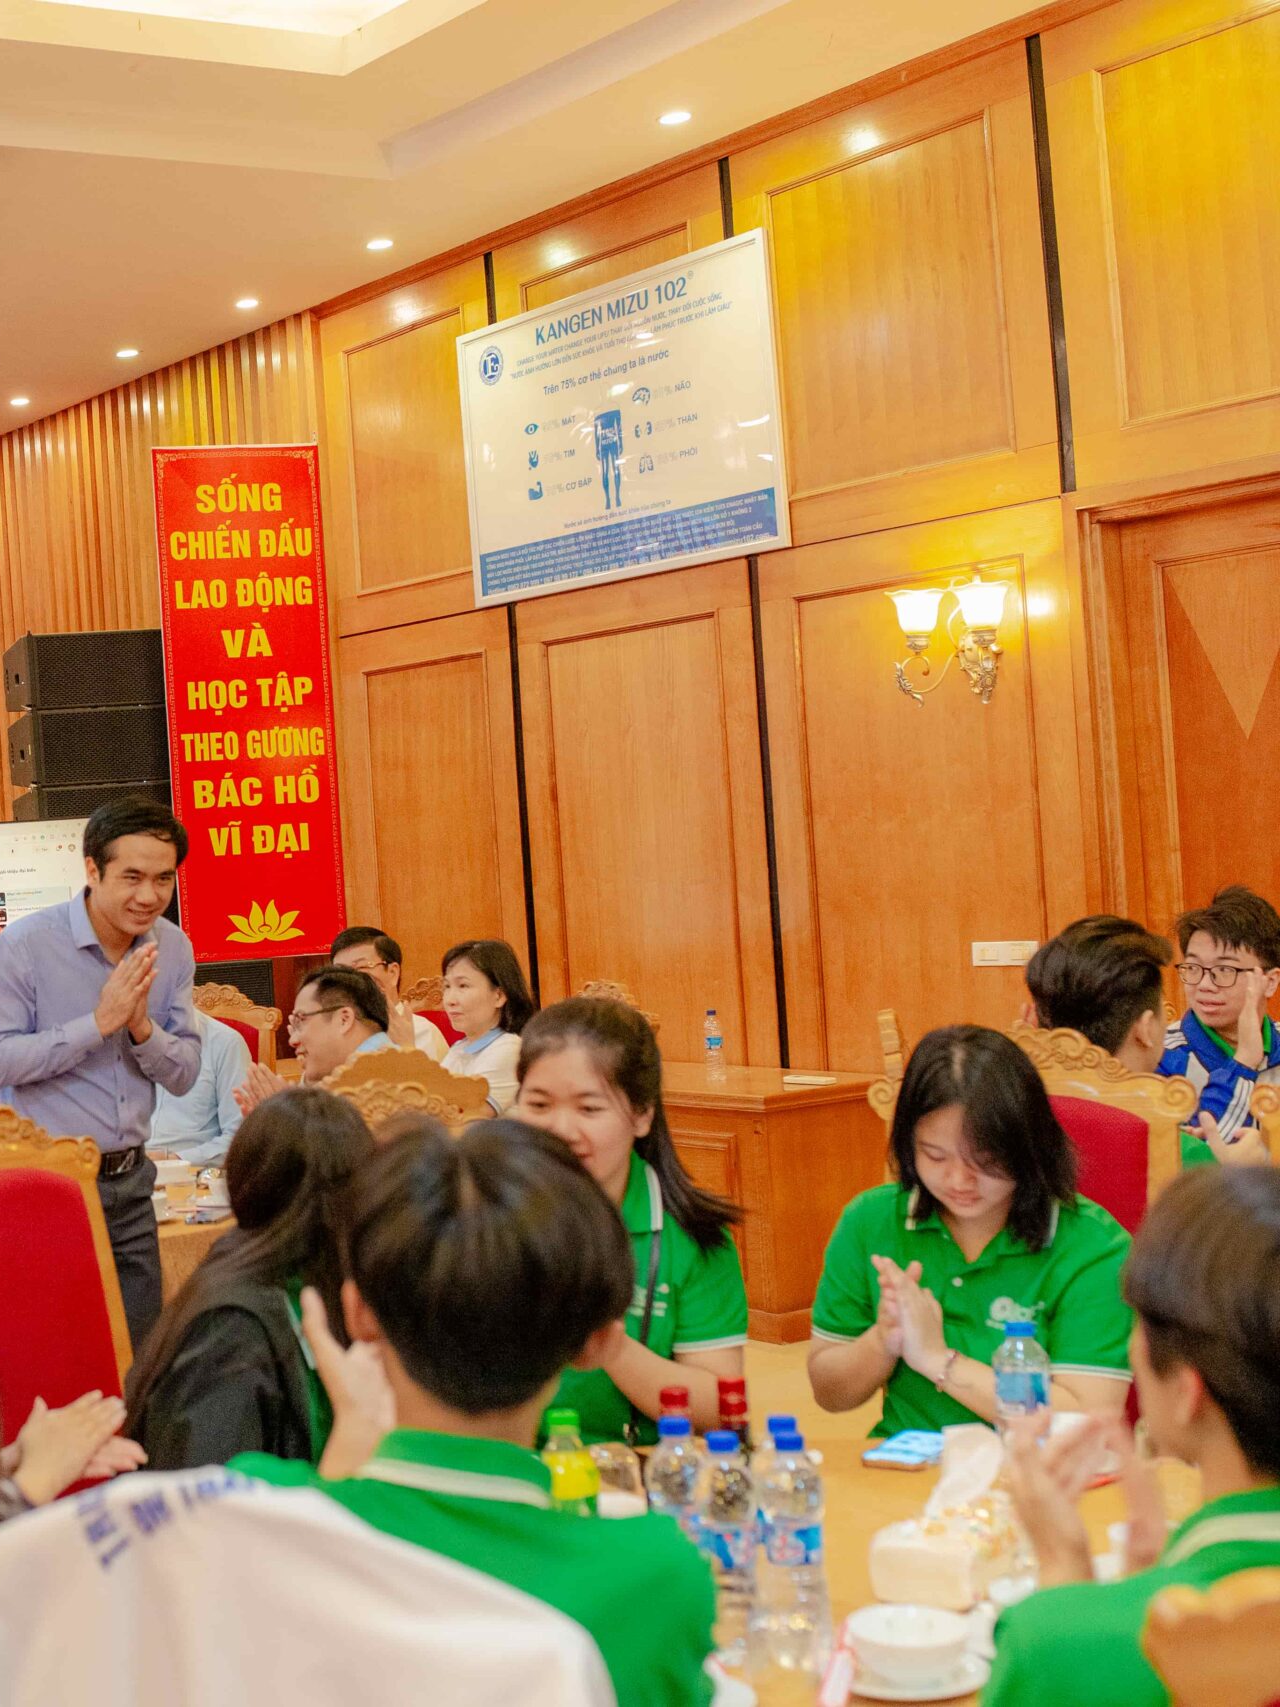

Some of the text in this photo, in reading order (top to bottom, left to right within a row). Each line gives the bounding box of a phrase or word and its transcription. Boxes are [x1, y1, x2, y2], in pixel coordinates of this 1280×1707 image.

[535, 276, 688, 346] KANGEN MIZU 102
[543, 384, 560, 396] Trên
[561, 378, 577, 390] 75%
[629, 358, 637, 369] ta
[563, 448, 576, 458] TIM
[195, 472, 283, 514] SỐNG
[170, 517, 313, 561] CHIẾN ĐẤU
[174, 571, 313, 613] LAO ĐỘNG
[220, 621, 274, 659] VÀ
[186, 671, 313, 716] HỌC TẬP
[180, 725, 326, 763] THEO GƯƠNG
[192, 763, 321, 810] BÁC HỒ
[208, 820, 311, 859] VĨ ĐẠI
